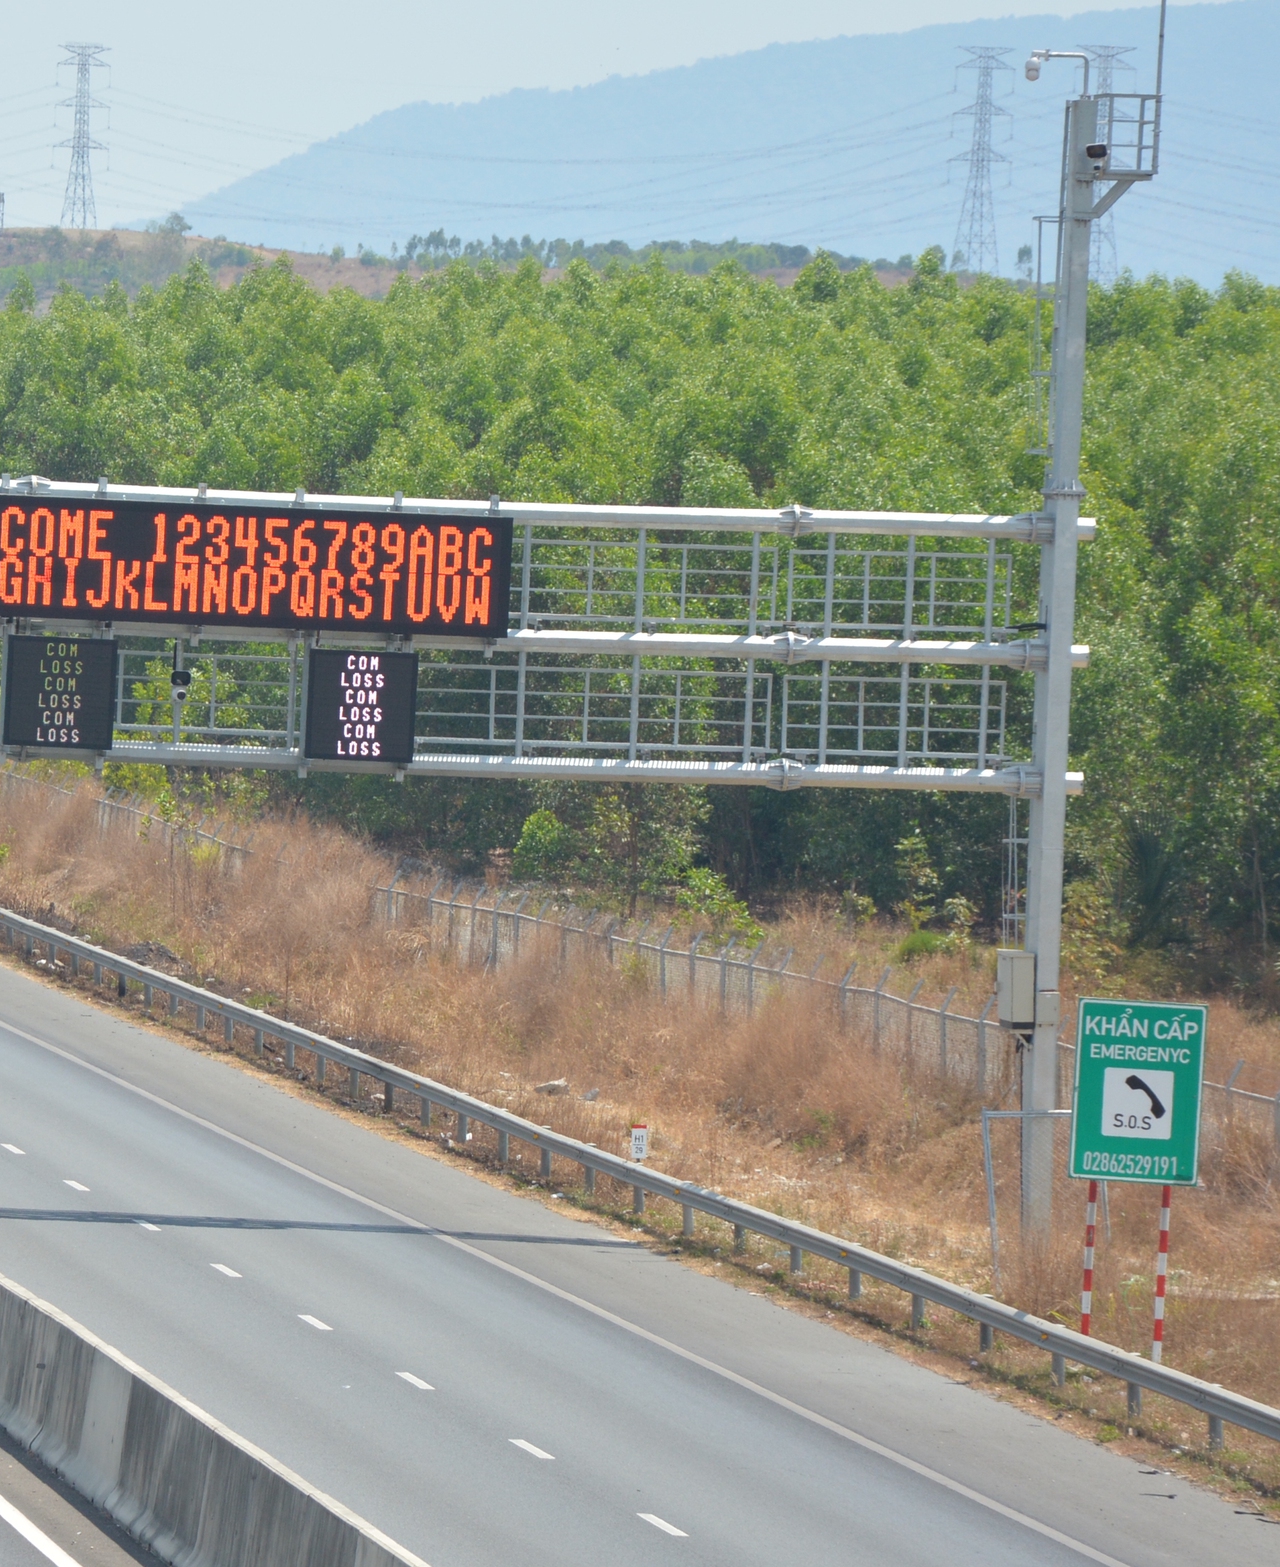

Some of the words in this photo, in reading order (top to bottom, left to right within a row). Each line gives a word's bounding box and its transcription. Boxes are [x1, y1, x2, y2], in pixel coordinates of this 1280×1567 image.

[153, 513, 493, 576] 123456789ABC
[46, 643, 78, 657] COM
[40, 659, 83, 675] LOSS
[347, 655, 379, 671] COM
[44, 677, 76, 692] COM
[341, 672, 385, 688] LOSS
[38, 693, 81, 709] LOSS
[345, 689, 377, 705] COM
[42, 711, 74, 726] COM
[339, 706, 382, 722] LOSS
[36, 727, 80, 743] LOSS
[343, 723, 375, 739] COM
[337, 740, 381, 756] LOSS
[1084, 1008, 1149, 1039] KHẨN
[1153, 1013, 1199, 1041] CẤP
[1090, 1043, 1191, 1064] EMERGENYC
[634, 1135, 644, 1143] H1
[634, 1146, 644, 1154] 29
[1083, 1151, 1178, 1176] 02862529191
